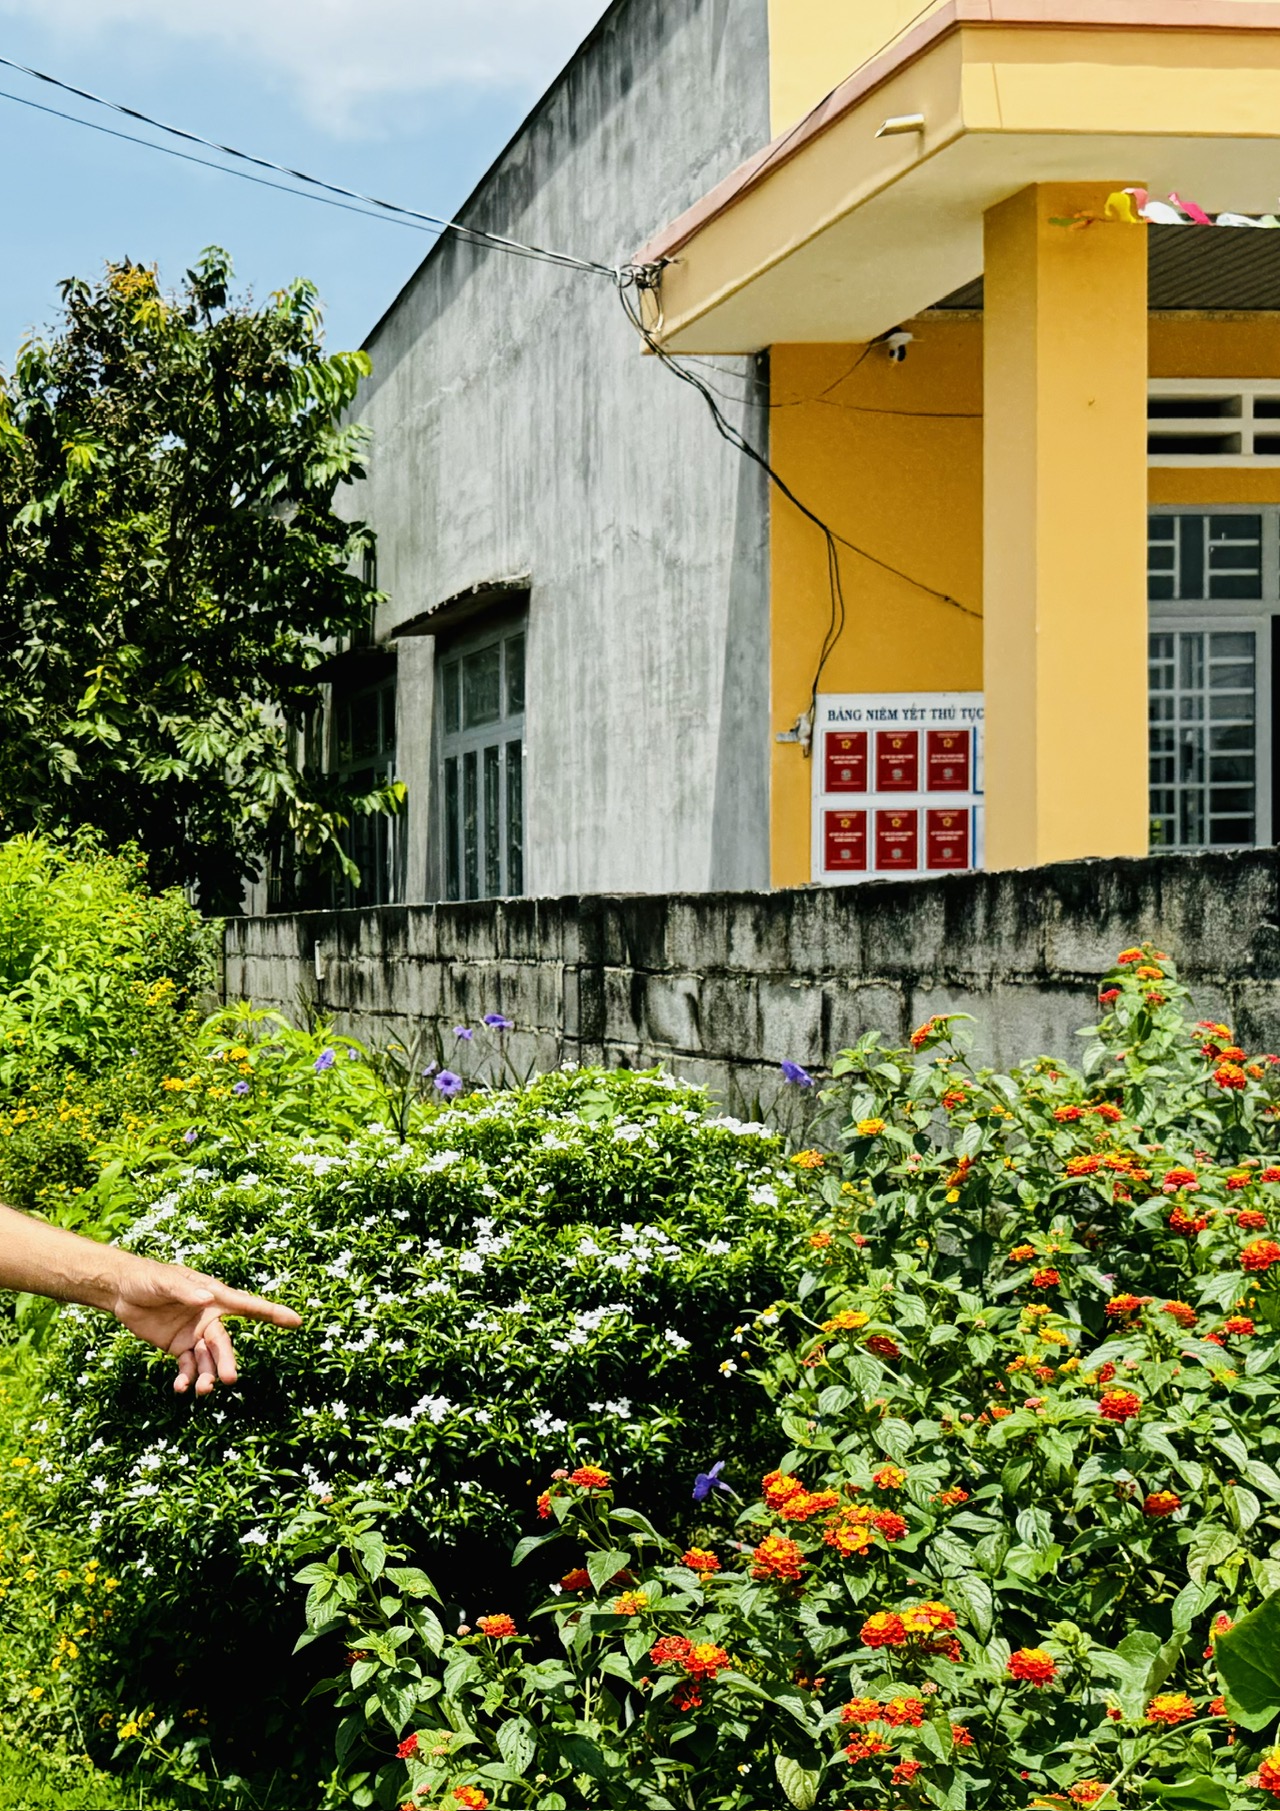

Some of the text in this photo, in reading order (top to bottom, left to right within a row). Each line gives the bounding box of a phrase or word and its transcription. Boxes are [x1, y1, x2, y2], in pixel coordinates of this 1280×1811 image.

[827, 705, 862, 721] BẢNG
[902, 702, 926, 721] YẾT
[929, 704, 956, 720] THỦ
[960, 707, 985, 722] TỤC
